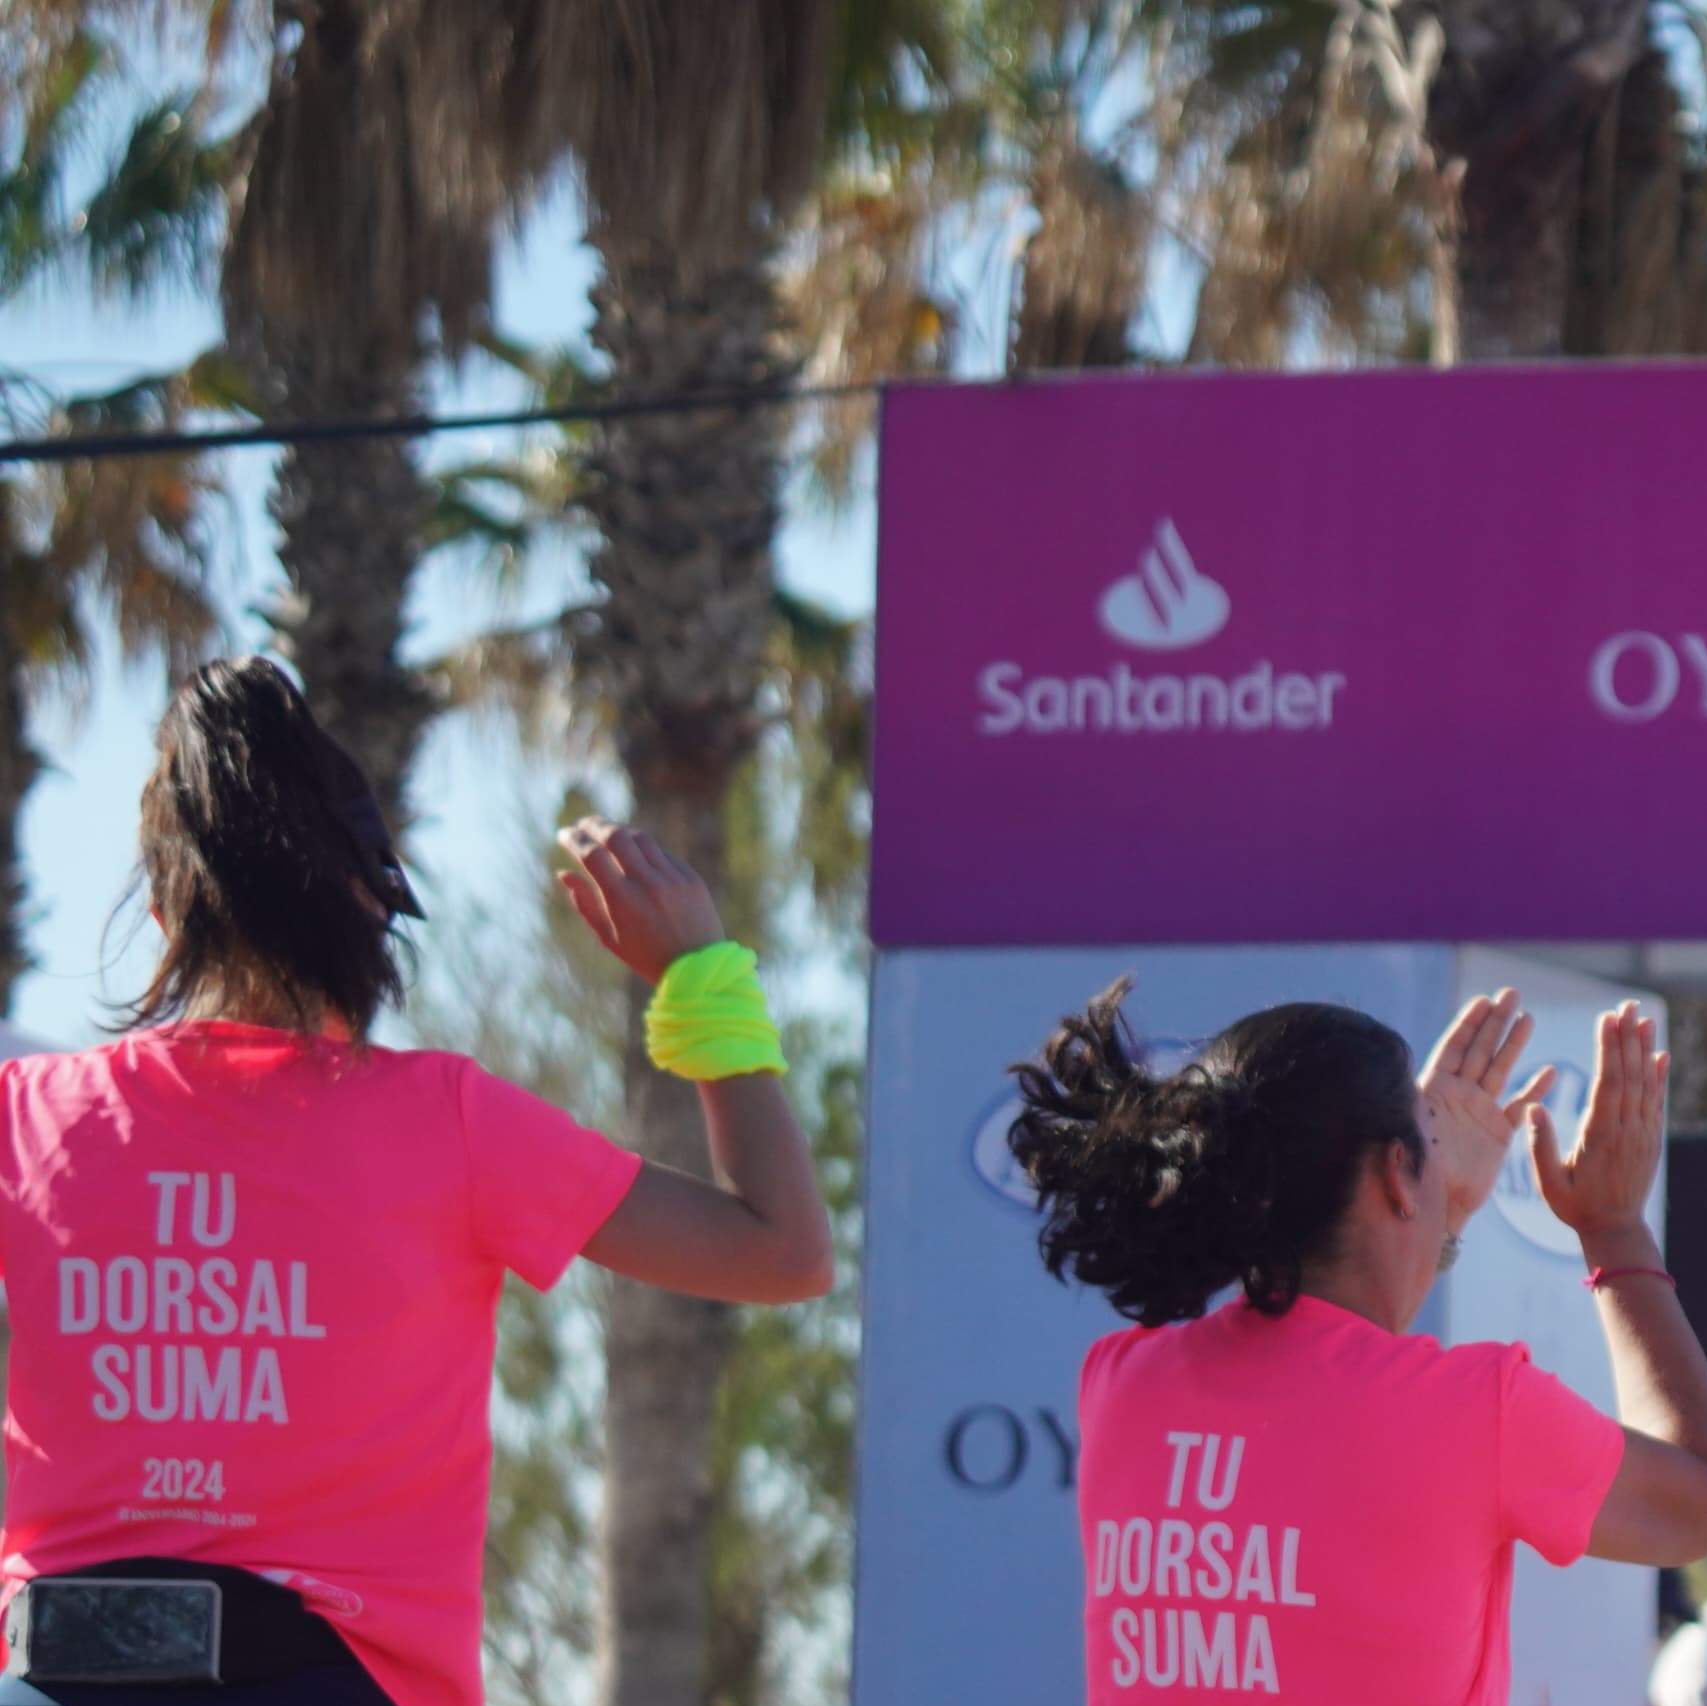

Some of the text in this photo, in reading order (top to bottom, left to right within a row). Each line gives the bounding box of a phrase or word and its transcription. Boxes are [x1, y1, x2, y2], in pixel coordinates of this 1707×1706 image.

[978, 658, 1347, 737] Santander
[149, 1172, 236, 1247] TU
[57, 1255, 326, 1339] DORSAL
[91, 1344, 289, 1424] SUMA
[143, 1456, 226, 1501] 2024
[1165, 1431, 1246, 1511] TU
[1095, 1517, 1317, 1607] DORSAL
[1111, 1607, 1280, 1694] SUMA
